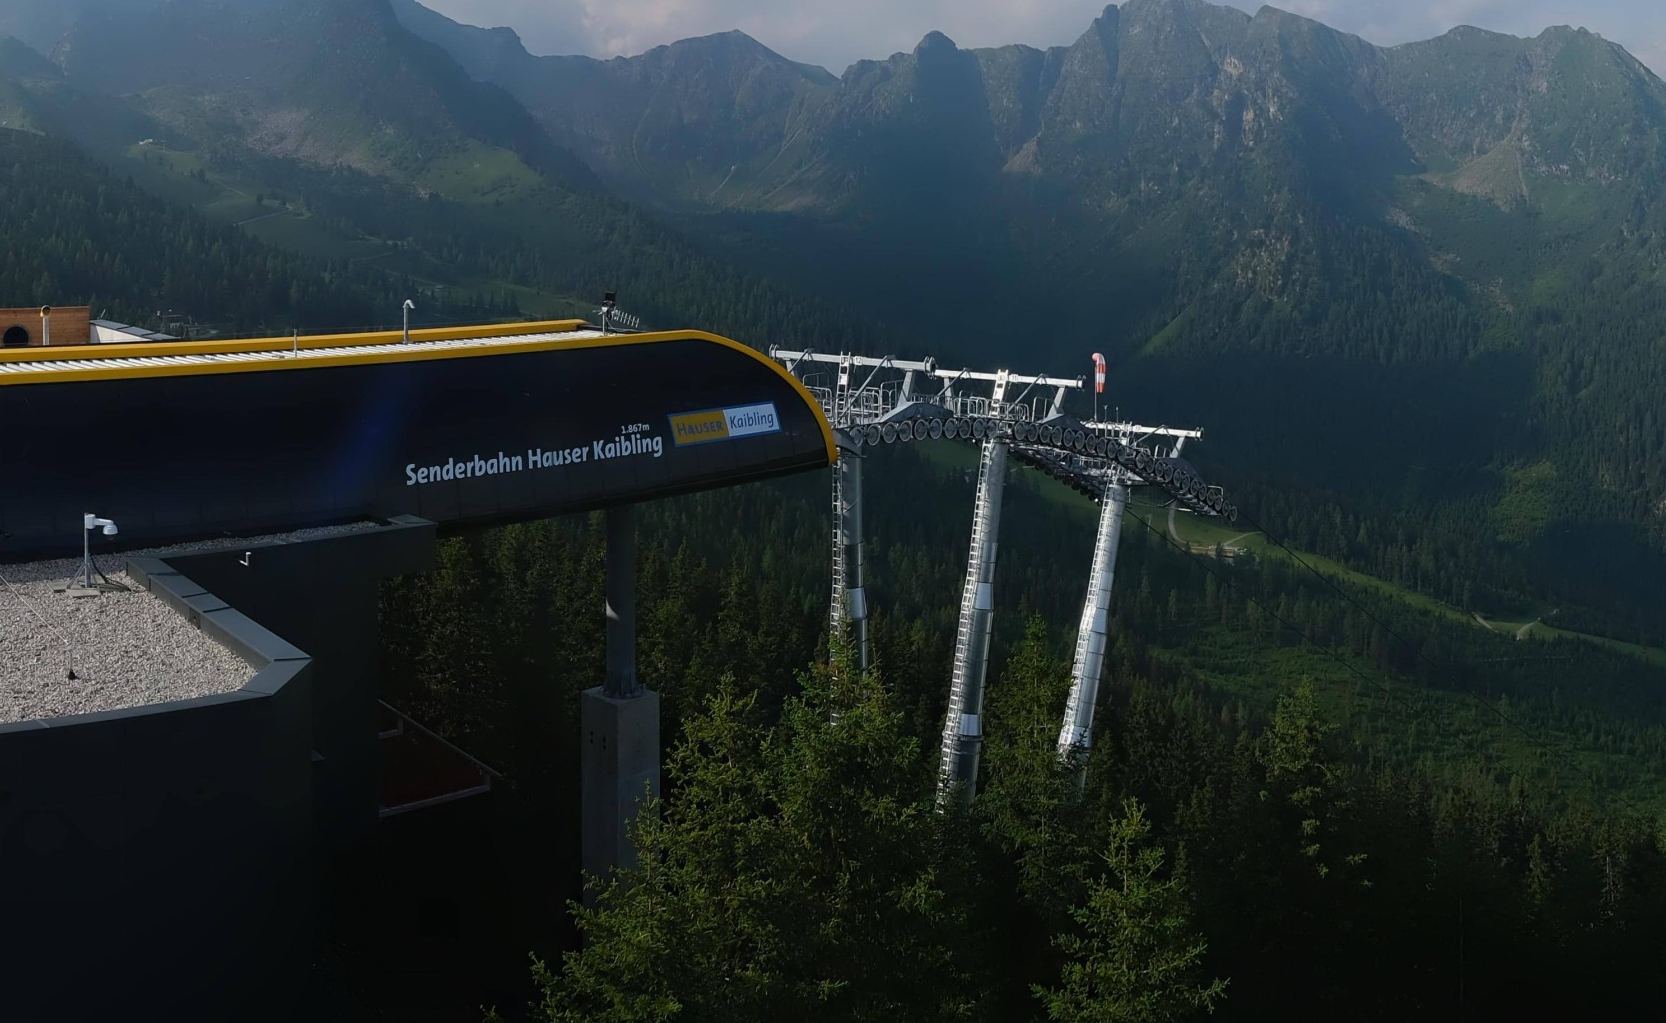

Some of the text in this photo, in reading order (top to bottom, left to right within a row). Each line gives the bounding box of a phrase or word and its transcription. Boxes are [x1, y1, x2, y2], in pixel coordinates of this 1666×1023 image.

[621, 423, 650, 434] 1.867m
[676, 411, 774, 436] HAUSER Kaibling
[405, 434, 663, 486] Senderbahn Hauser Kaibling
